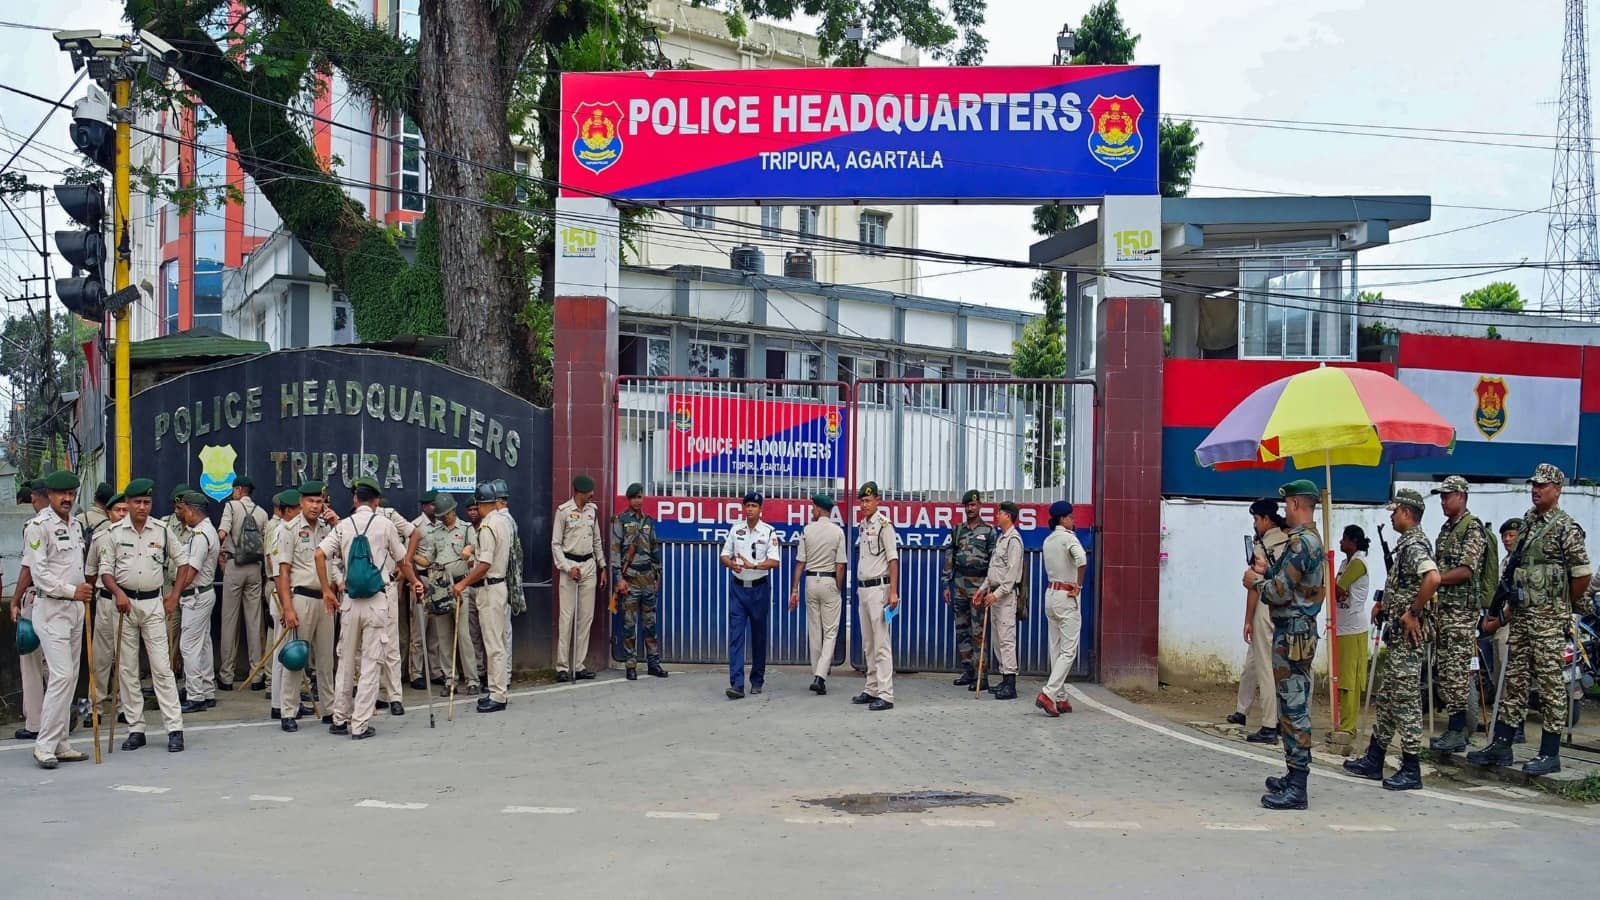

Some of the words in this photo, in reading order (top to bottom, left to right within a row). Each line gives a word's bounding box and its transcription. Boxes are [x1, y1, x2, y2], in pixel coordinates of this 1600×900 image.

[629, 96, 760, 136] POLICE
[773, 92, 1082, 134] HEADQUARTERS
[759, 152, 840, 172] TRIPURA,
[845, 150, 944, 169] AGARTALA
[560, 228, 597, 253] 150
[1112, 230, 1153, 256] 150
[154, 385, 263, 451] POLICE
[280, 379, 521, 468] HEADQUARTERS
[687, 436, 733, 455] POLICE
[736, 438, 832, 459] HEADQUARTERS
[270, 451, 404, 489] TRIPURA
[428, 451, 475, 484] 150
[657, 501, 763, 524] POLIC
[698, 528, 801, 543] TRRA
